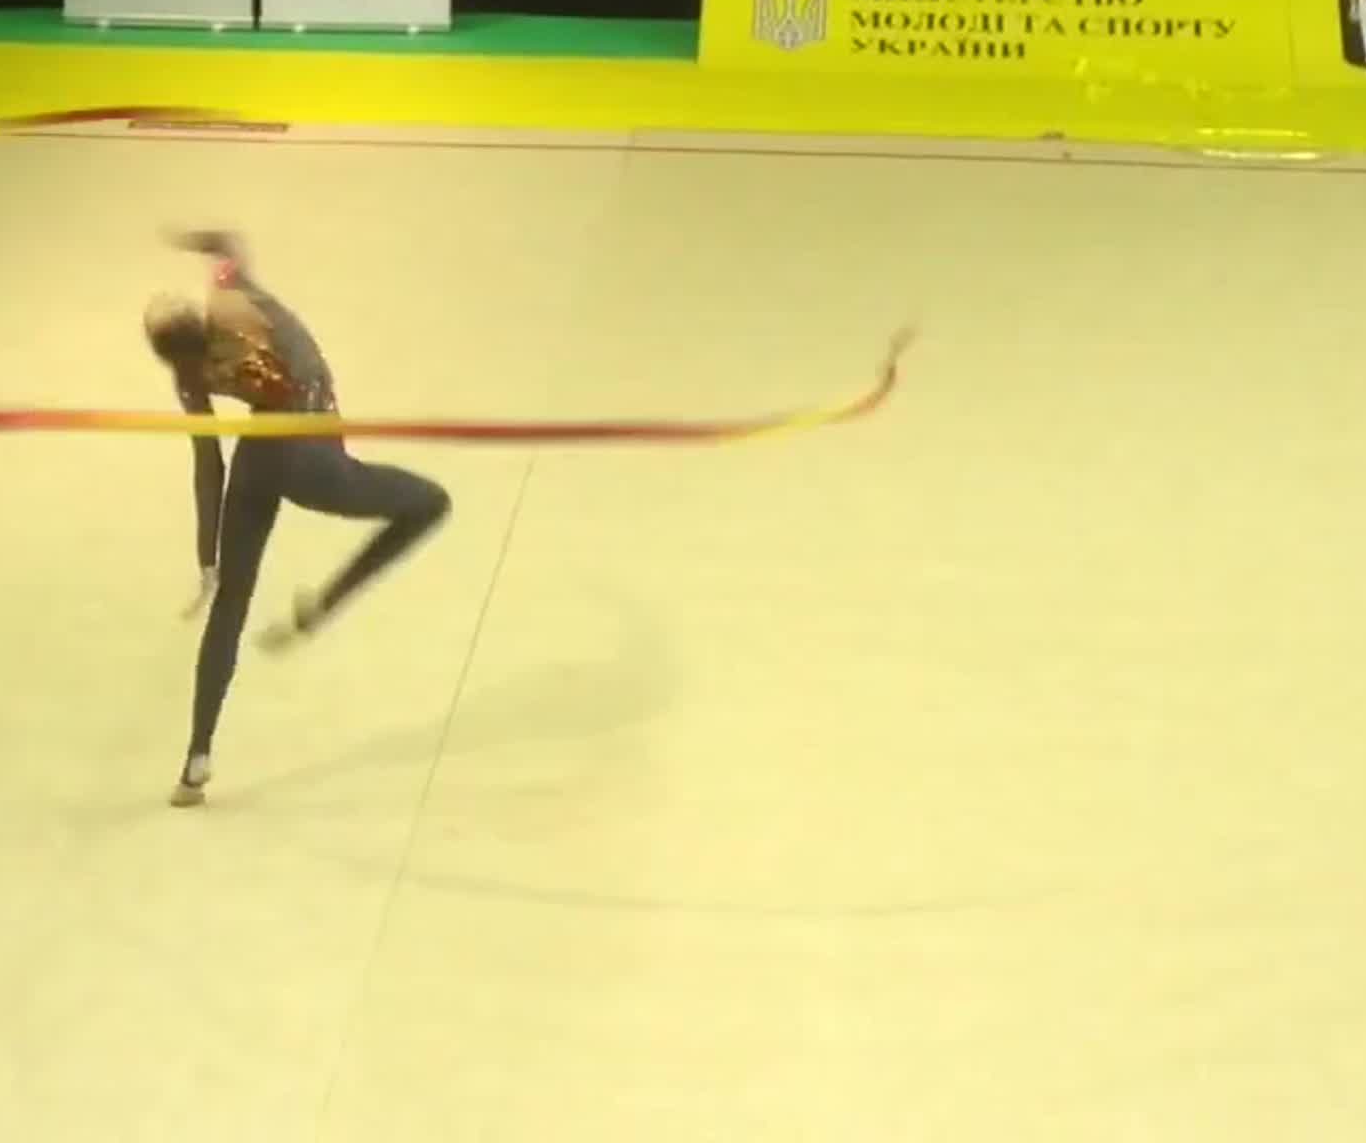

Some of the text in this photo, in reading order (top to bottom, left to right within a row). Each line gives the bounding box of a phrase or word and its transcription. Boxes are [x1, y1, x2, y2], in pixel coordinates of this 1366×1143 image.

[852, 10, 1236, 40] МОЛОДІ ТА СПОРТУ
